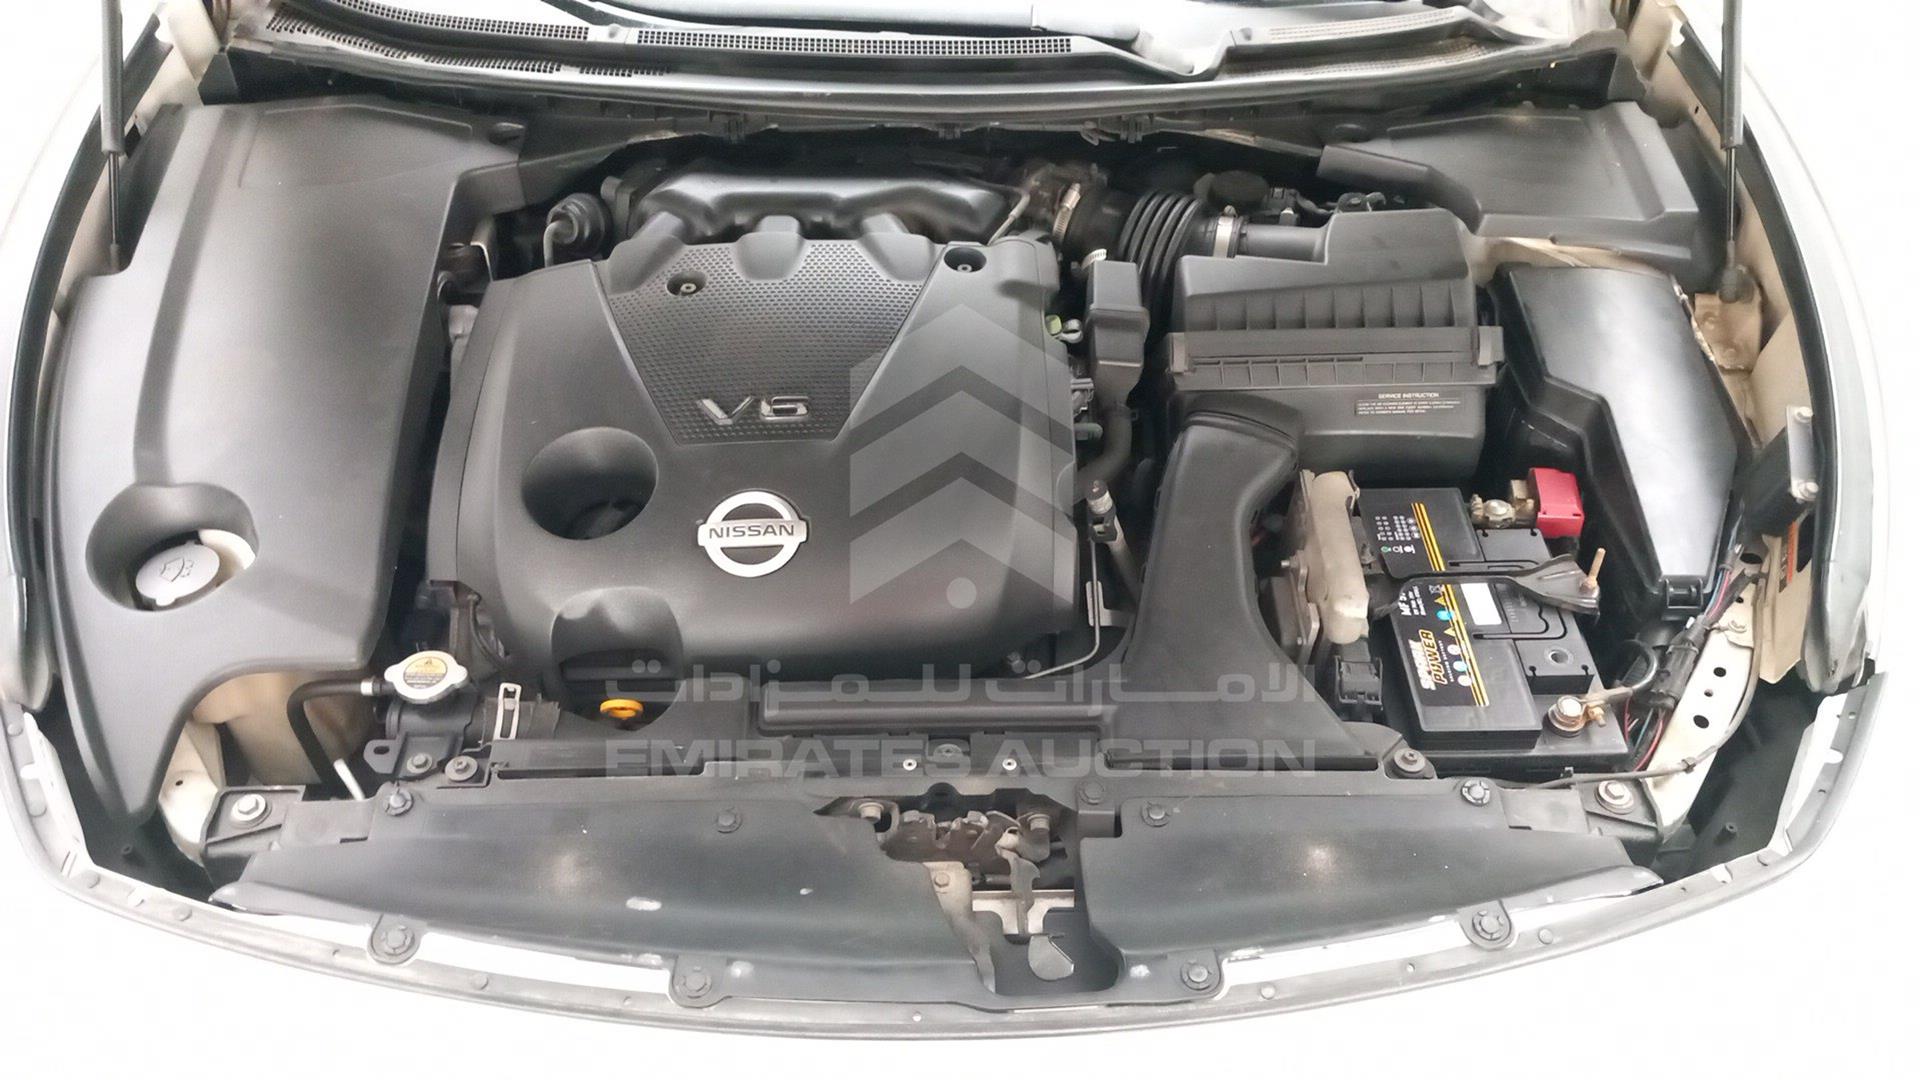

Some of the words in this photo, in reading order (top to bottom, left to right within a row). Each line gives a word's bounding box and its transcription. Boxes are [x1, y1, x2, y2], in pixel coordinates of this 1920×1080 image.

[697, 396, 810, 426] V6
[709, 524, 794, 539] NISSAN
[1418, 629, 1448, 685] POWER
